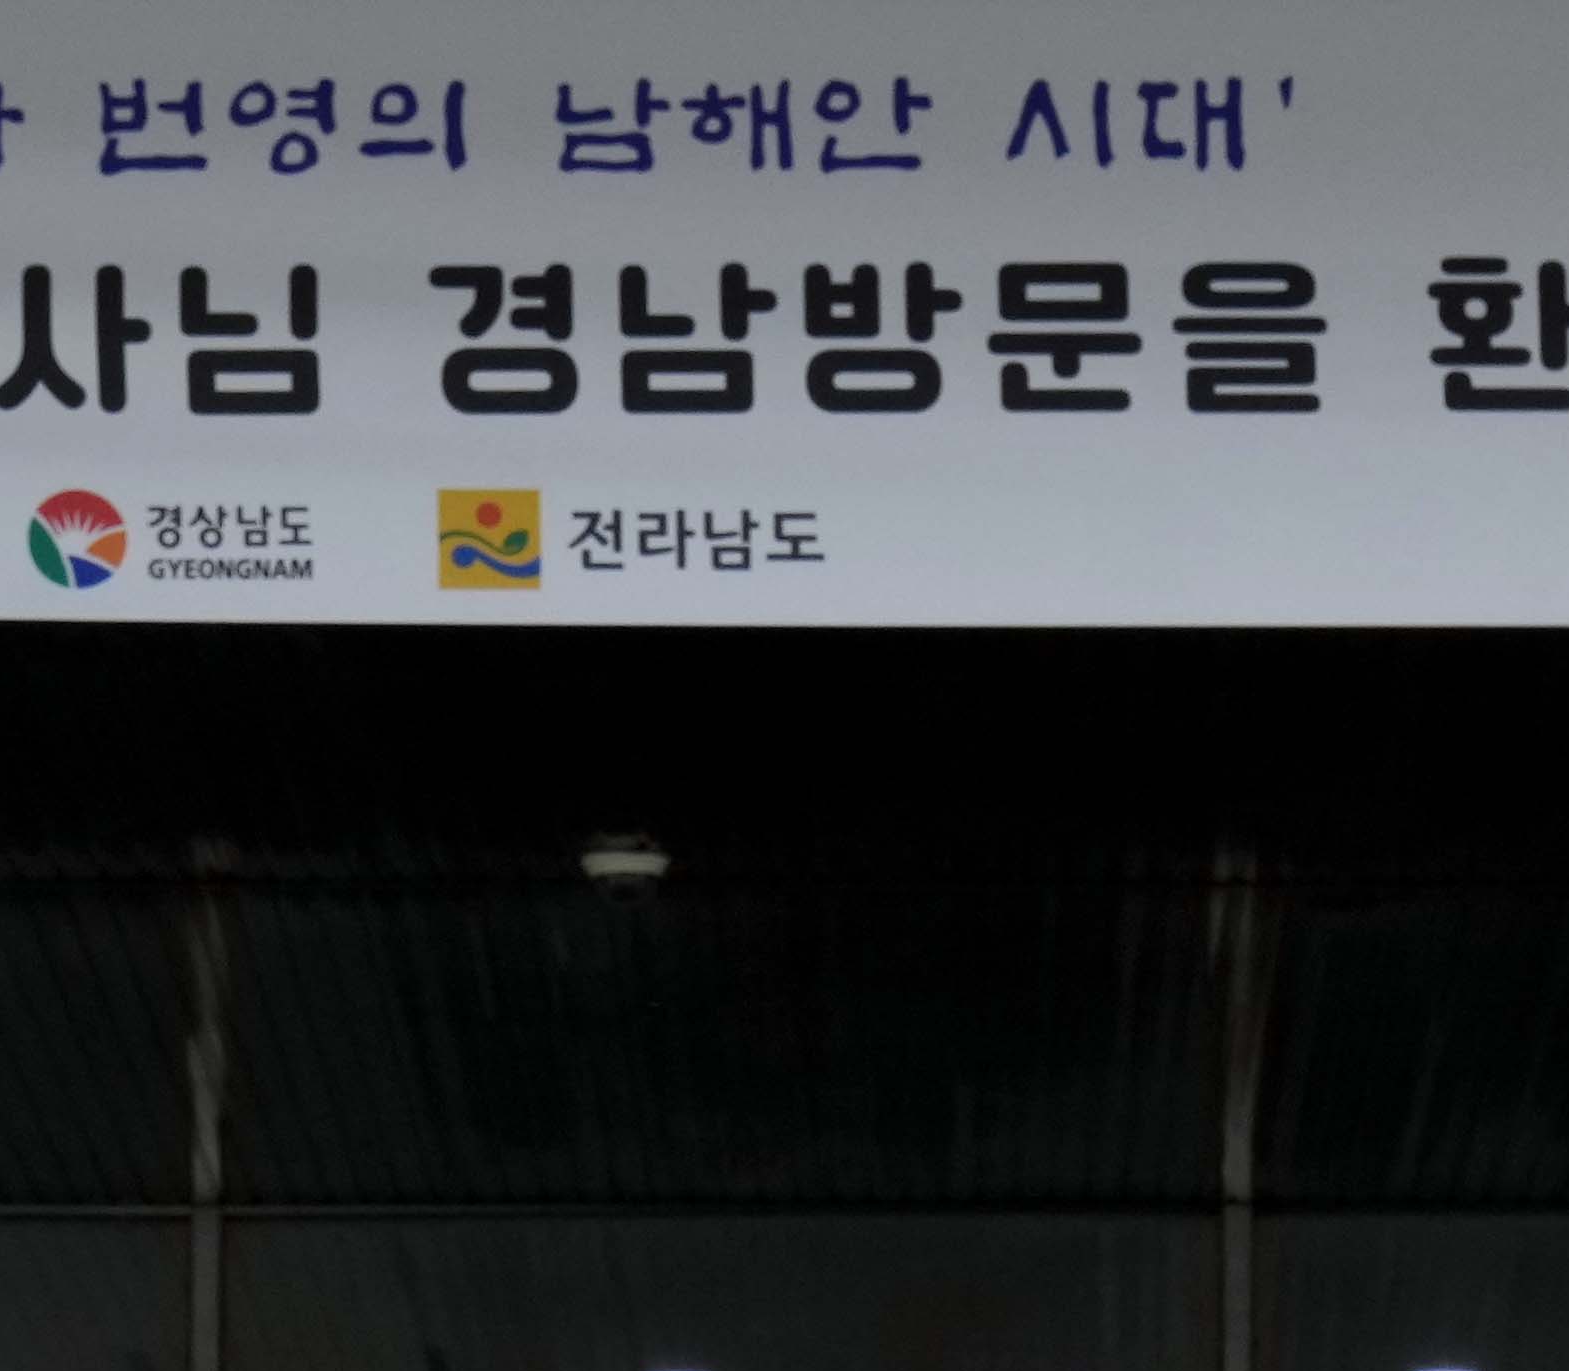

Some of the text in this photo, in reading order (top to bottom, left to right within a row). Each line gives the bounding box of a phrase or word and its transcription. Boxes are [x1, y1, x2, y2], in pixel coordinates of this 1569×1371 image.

[98, 77, 470, 178] 번영의
[555, 76, 935, 176] 남해안
[1005, 75, 1296, 173] 시대'
[427, 260, 1330, 418] 경남방문을
[147, 504, 315, 551] 경상남도
[567, 507, 827, 574] 전라남도
[147, 558, 315, 582] GYEONGNAM
